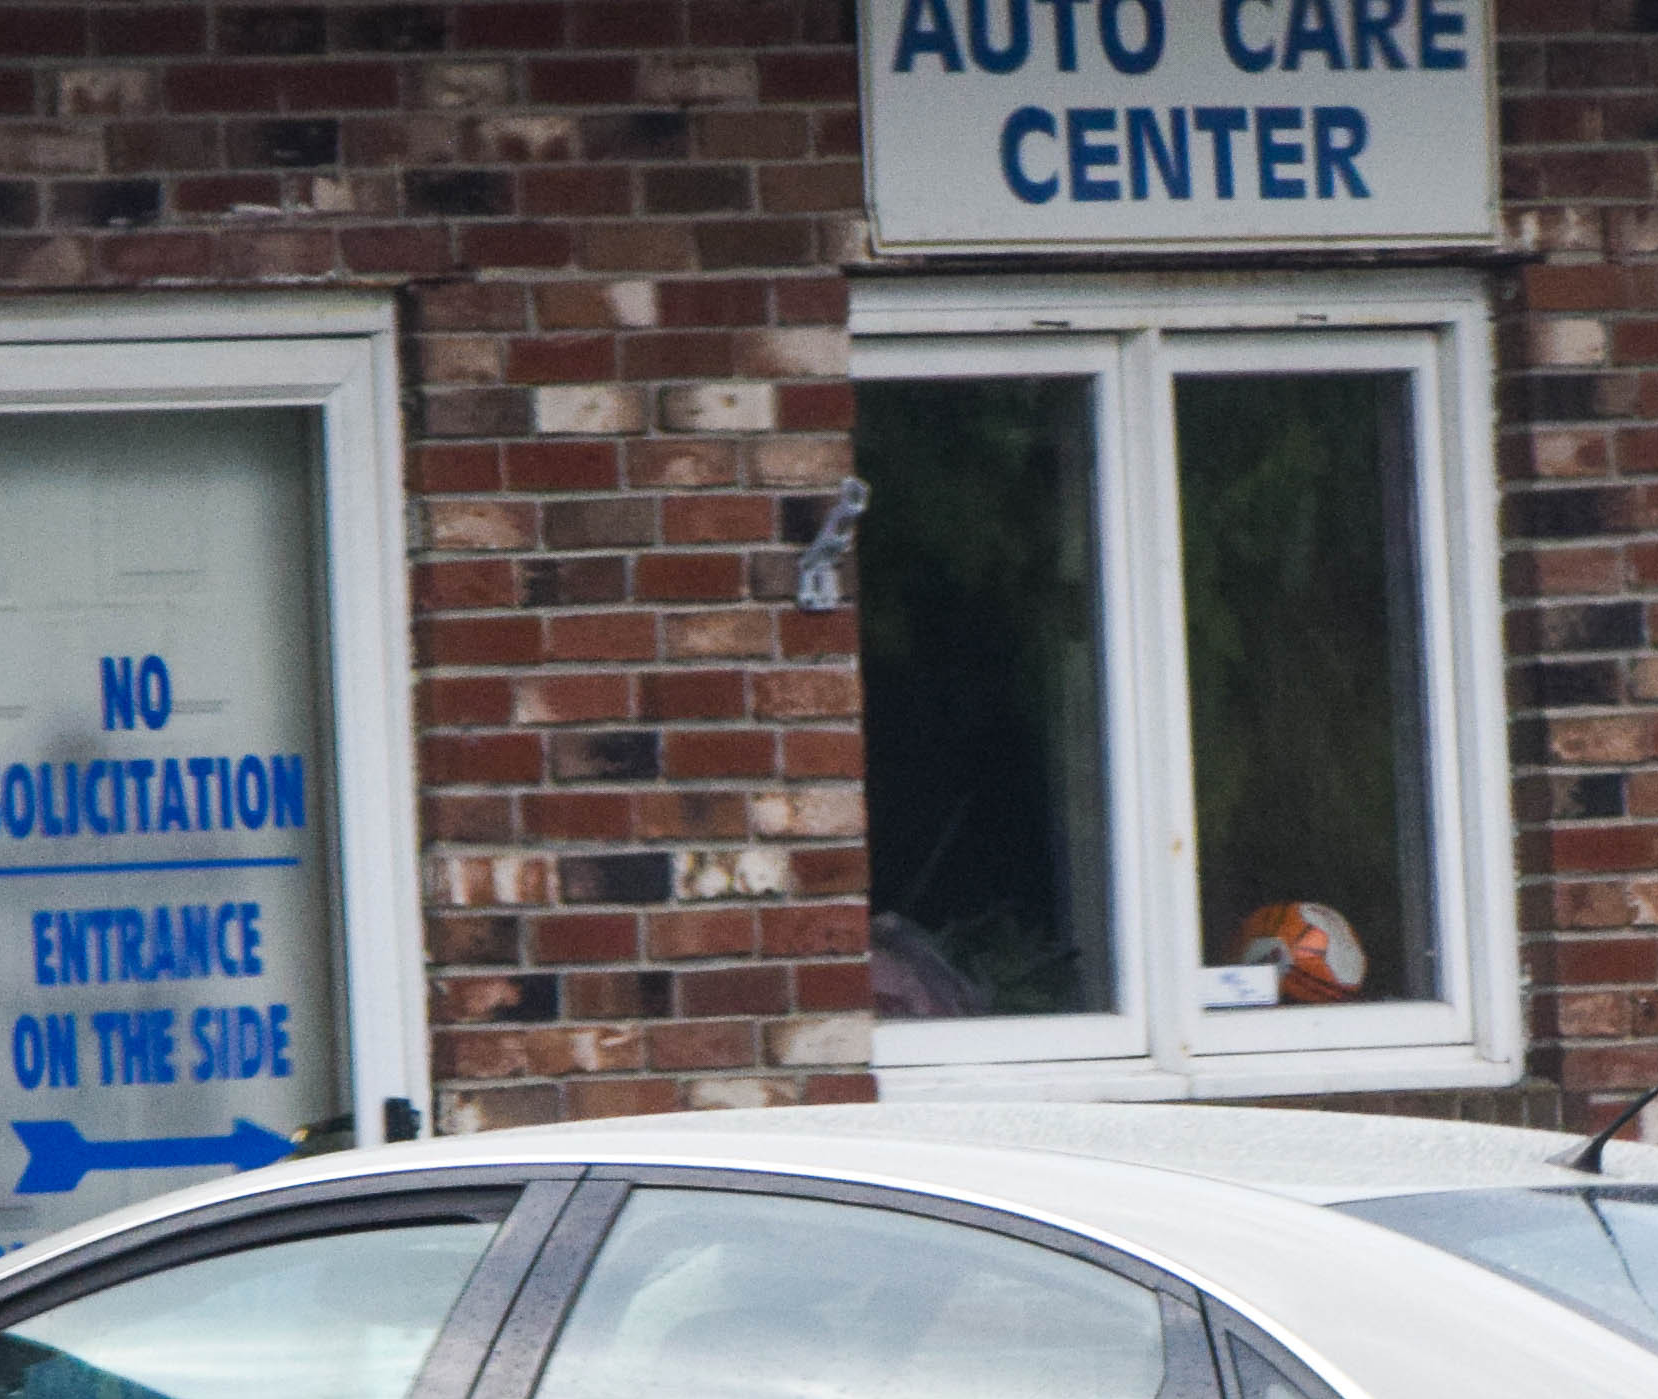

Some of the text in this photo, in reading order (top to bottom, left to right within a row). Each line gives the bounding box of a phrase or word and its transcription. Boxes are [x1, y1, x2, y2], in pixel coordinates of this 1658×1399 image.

[892, 0, 1467, 75] AUTO CARE
[998, 105, 1372, 205] CENTER
[99, 655, 172, 731] NO
[32, 902, 263, 986] ENTRANCE
[13, 1004, 292, 1090] ON THE SIDE
